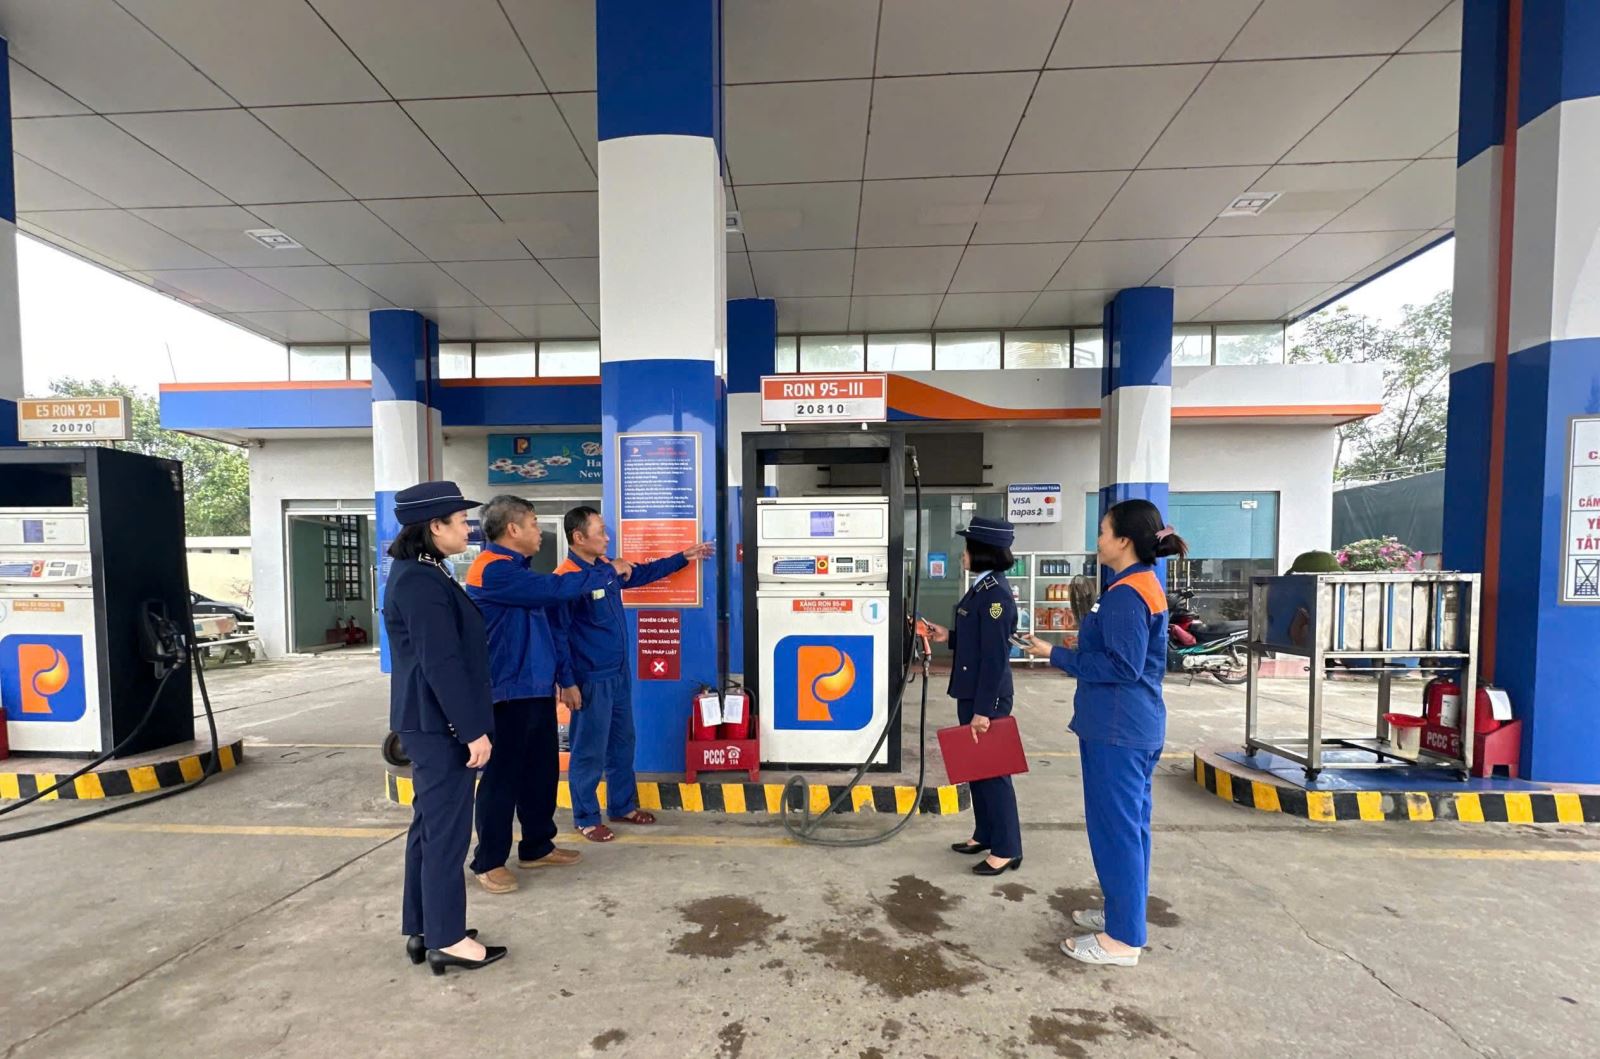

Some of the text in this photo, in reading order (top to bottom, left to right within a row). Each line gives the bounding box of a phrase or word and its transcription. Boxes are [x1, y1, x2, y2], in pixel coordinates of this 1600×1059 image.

[783, 382, 863, 397] RON 95-III
[36, 403, 106, 417] E5 RON 92-II
[797, 404, 844, 415] 20810
[52, 423, 92, 433] 20070
[579, 470, 601, 478] New
[869, 603, 878, 619] 1
[1426, 731, 1448, 750] PCCC
[703, 749, 725, 765] PCCC
